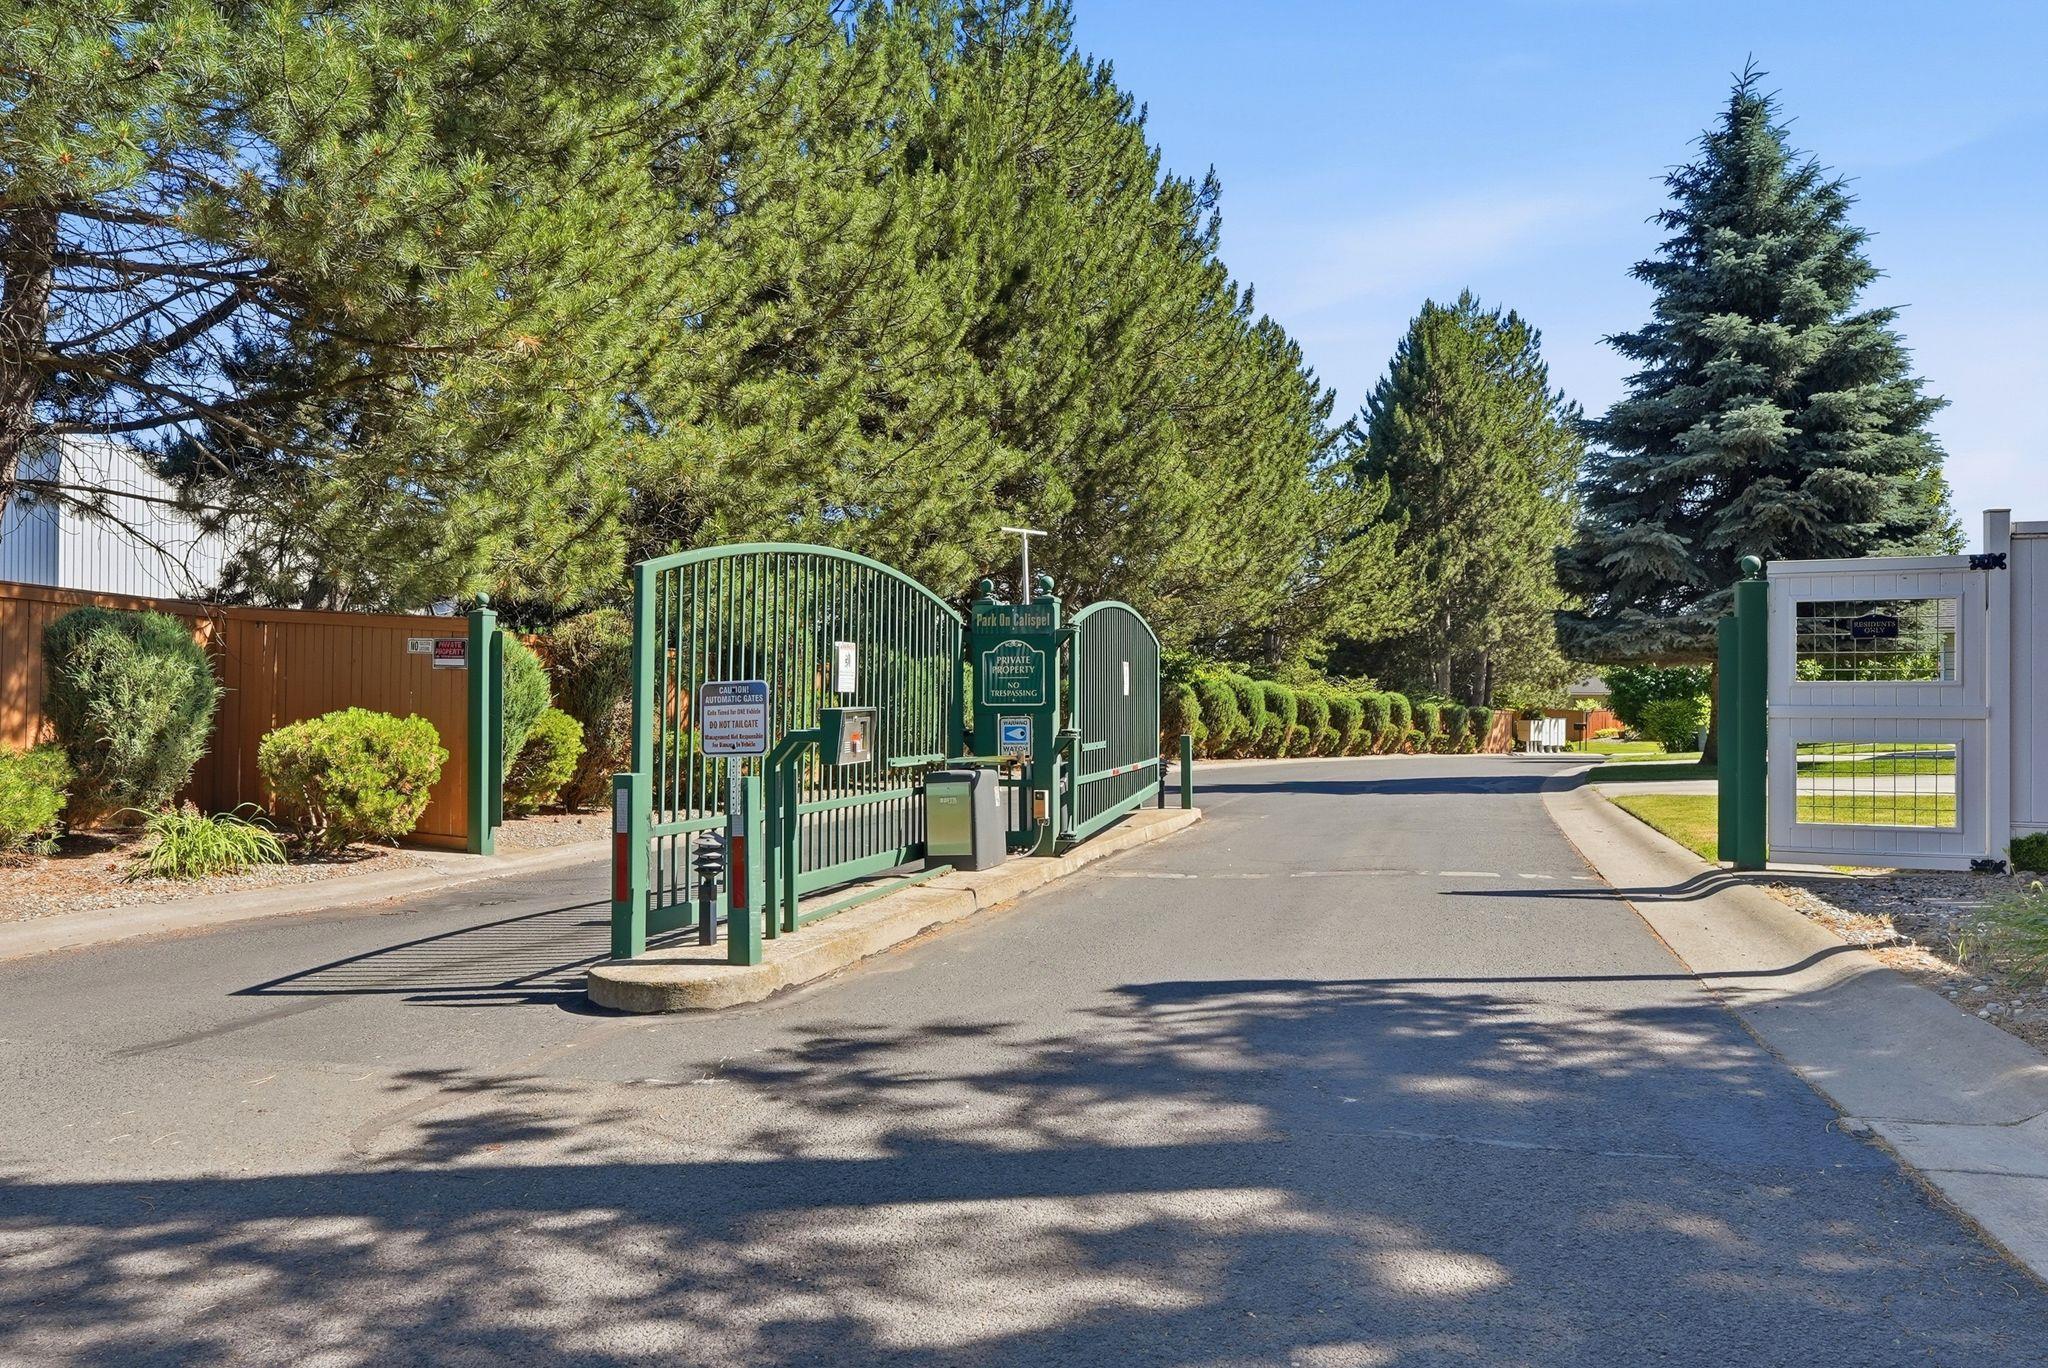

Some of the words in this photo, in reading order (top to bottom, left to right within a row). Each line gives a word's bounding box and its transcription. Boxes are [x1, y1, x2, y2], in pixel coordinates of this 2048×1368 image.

[976, 614, 996, 626] Park
[1000, 614, 1010, 626] On
[1014, 612, 1050, 628] Calispel
[410, 641, 418, 650] NO
[996, 656, 1031, 664] PRIVATE
[992, 666, 1035, 674] PROPERTY
[719, 686, 750, 694] CAUION!
[705, 695, 742, 704] AUTOMATIC
[743, 694, 764, 702] GATES
[710, 721, 718, 729] DO
[719, 720, 730, 728] NOT
[732, 720, 758, 728] TAILGATE
